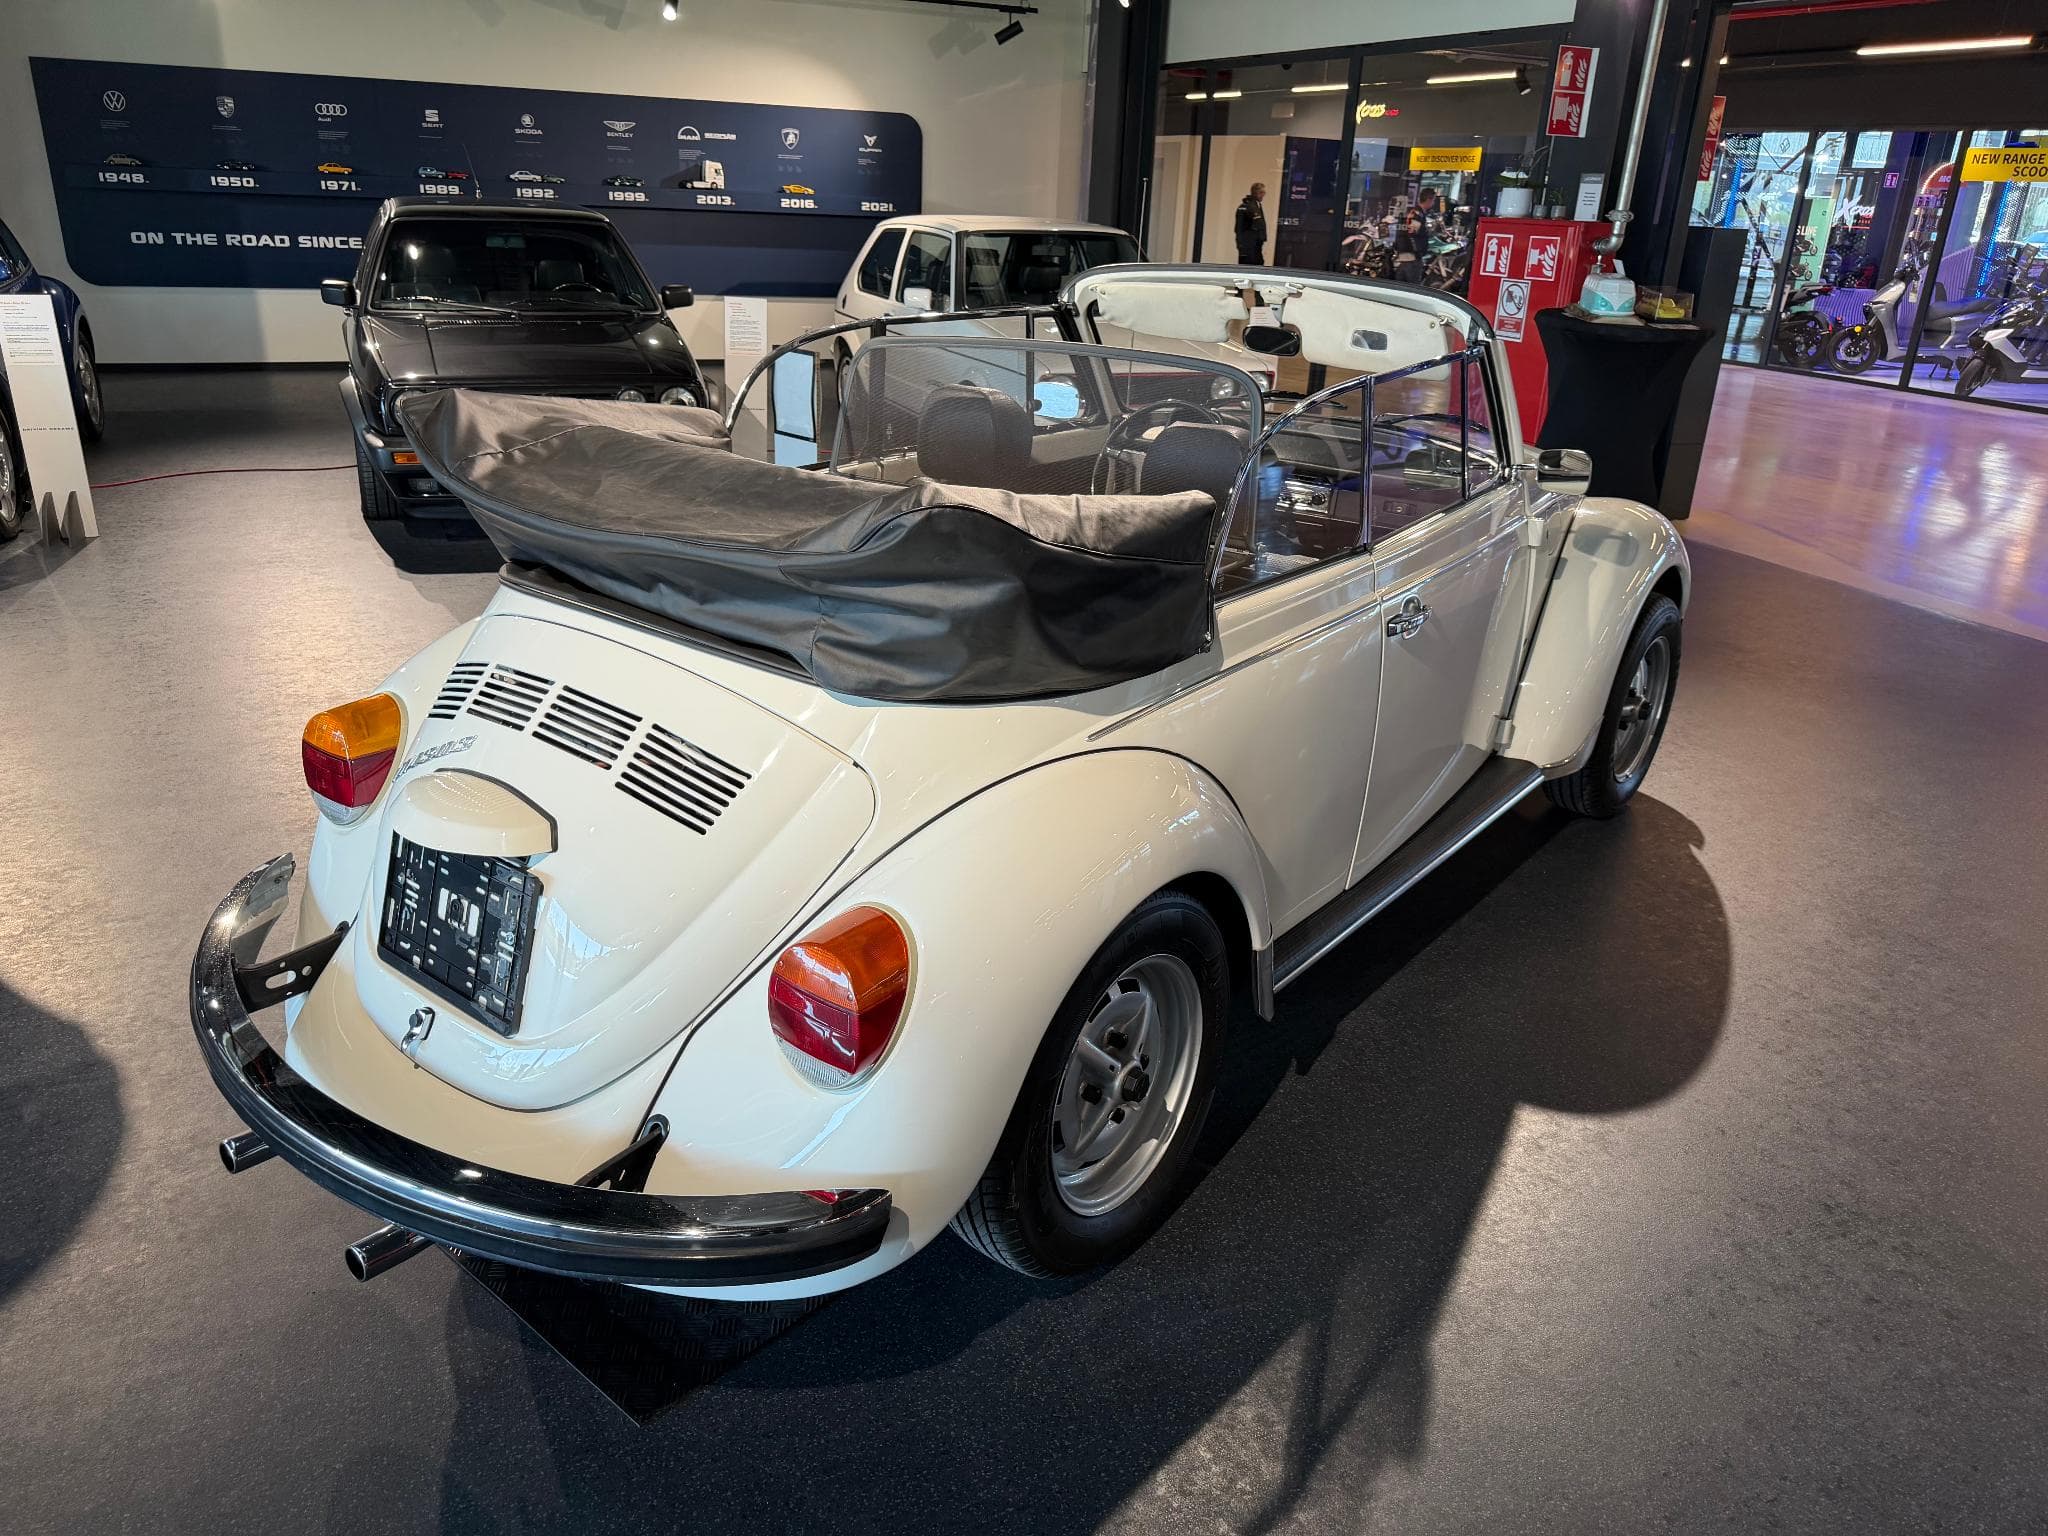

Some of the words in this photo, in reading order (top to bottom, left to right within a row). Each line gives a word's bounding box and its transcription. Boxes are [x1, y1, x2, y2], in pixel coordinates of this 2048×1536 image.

[1971, 153, 2001, 165] NEW
[2002, 153, 2047, 165] RANGE
[98, 171, 150, 184] 1948.
[2012, 166, 2048, 177] SCOO
[210, 175, 260, 188] 1950.
[320, 179, 362, 192] 1971.
[419, 183, 465, 195] 1989.
[516, 187, 559, 199] 1992.
[608, 191, 650, 202] 1999.
[696, 194, 736, 206] 2013.
[780, 198, 818, 209] 2016.
[861, 201, 897, 212] 2021.
[130, 231, 164, 245] ON
[171, 232, 218, 246] THE
[225, 234, 290, 247] ROAD
